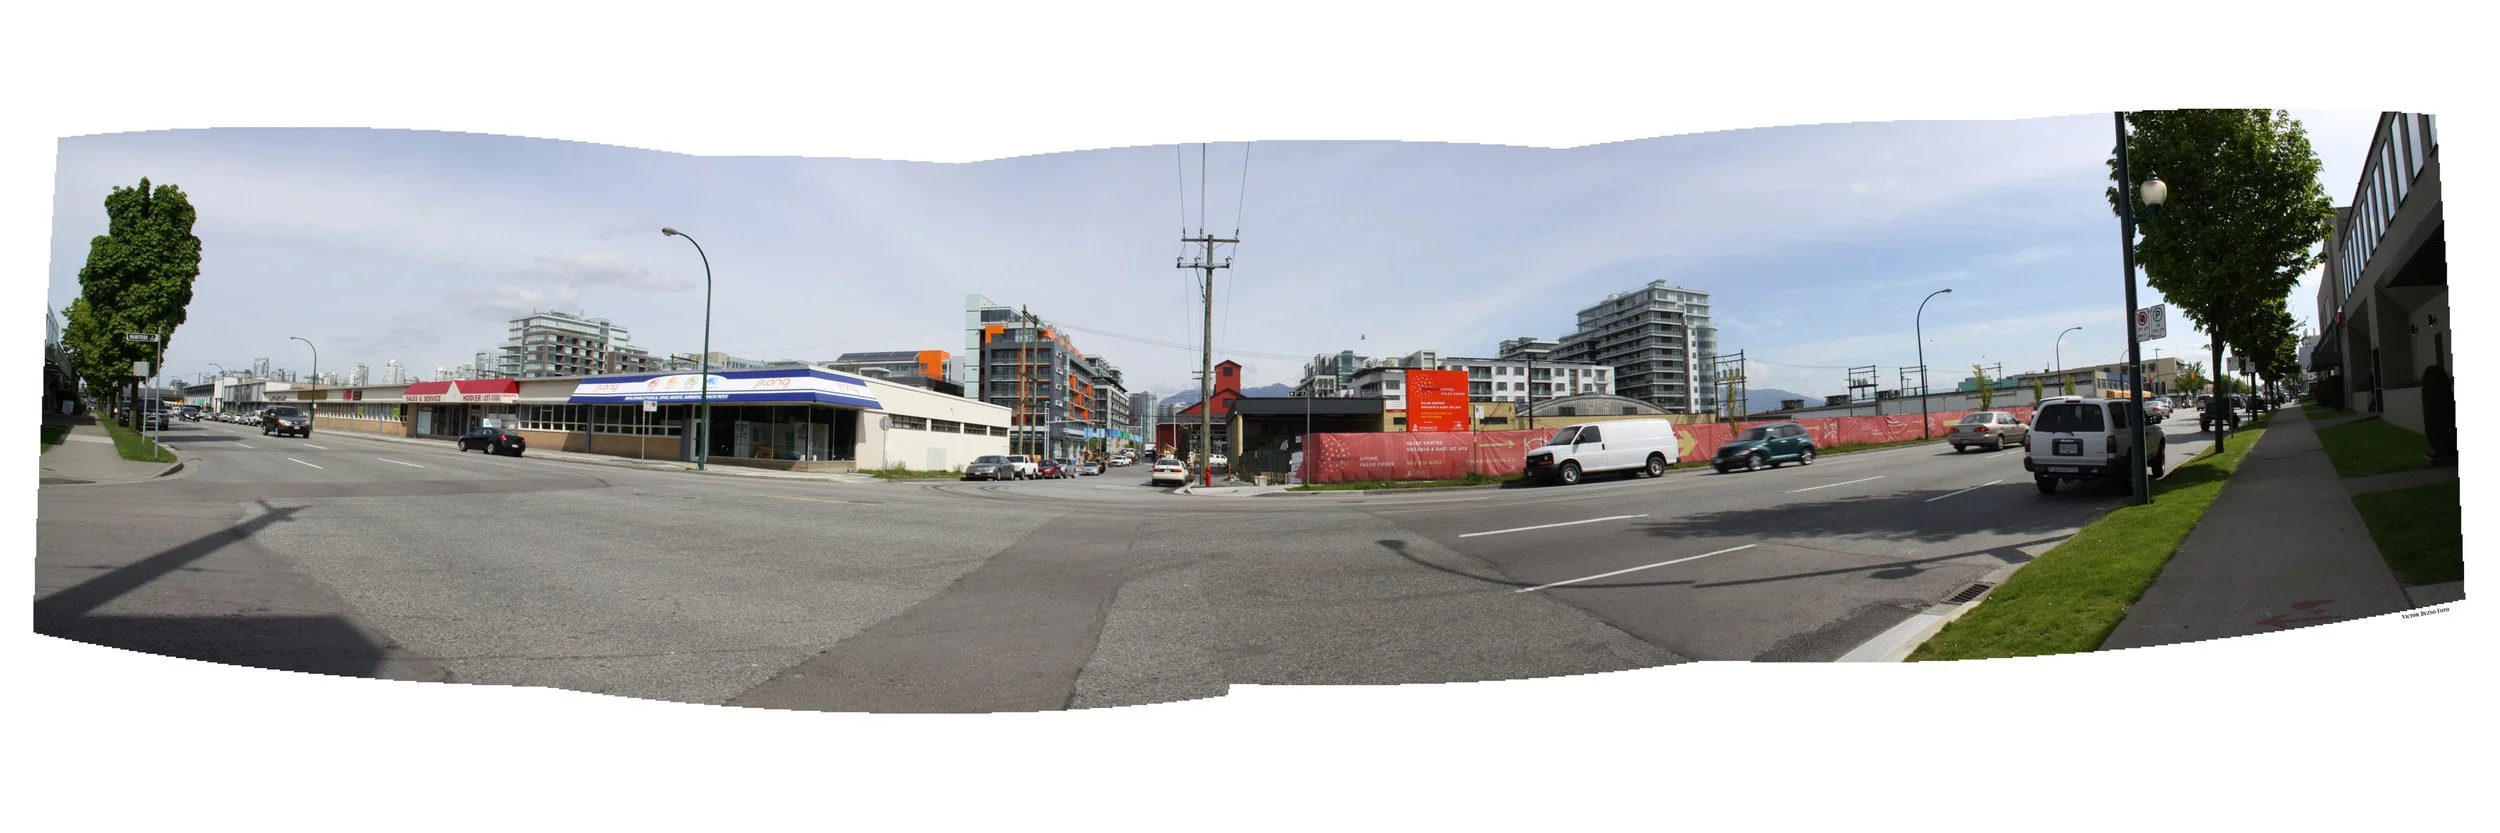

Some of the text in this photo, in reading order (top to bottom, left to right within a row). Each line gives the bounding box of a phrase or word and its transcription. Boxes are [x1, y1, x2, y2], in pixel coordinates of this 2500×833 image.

[406, 394, 418, 402] SALES
[424, 394, 441, 402] SERVICE
[463, 394, 481, 402] HOOVER
